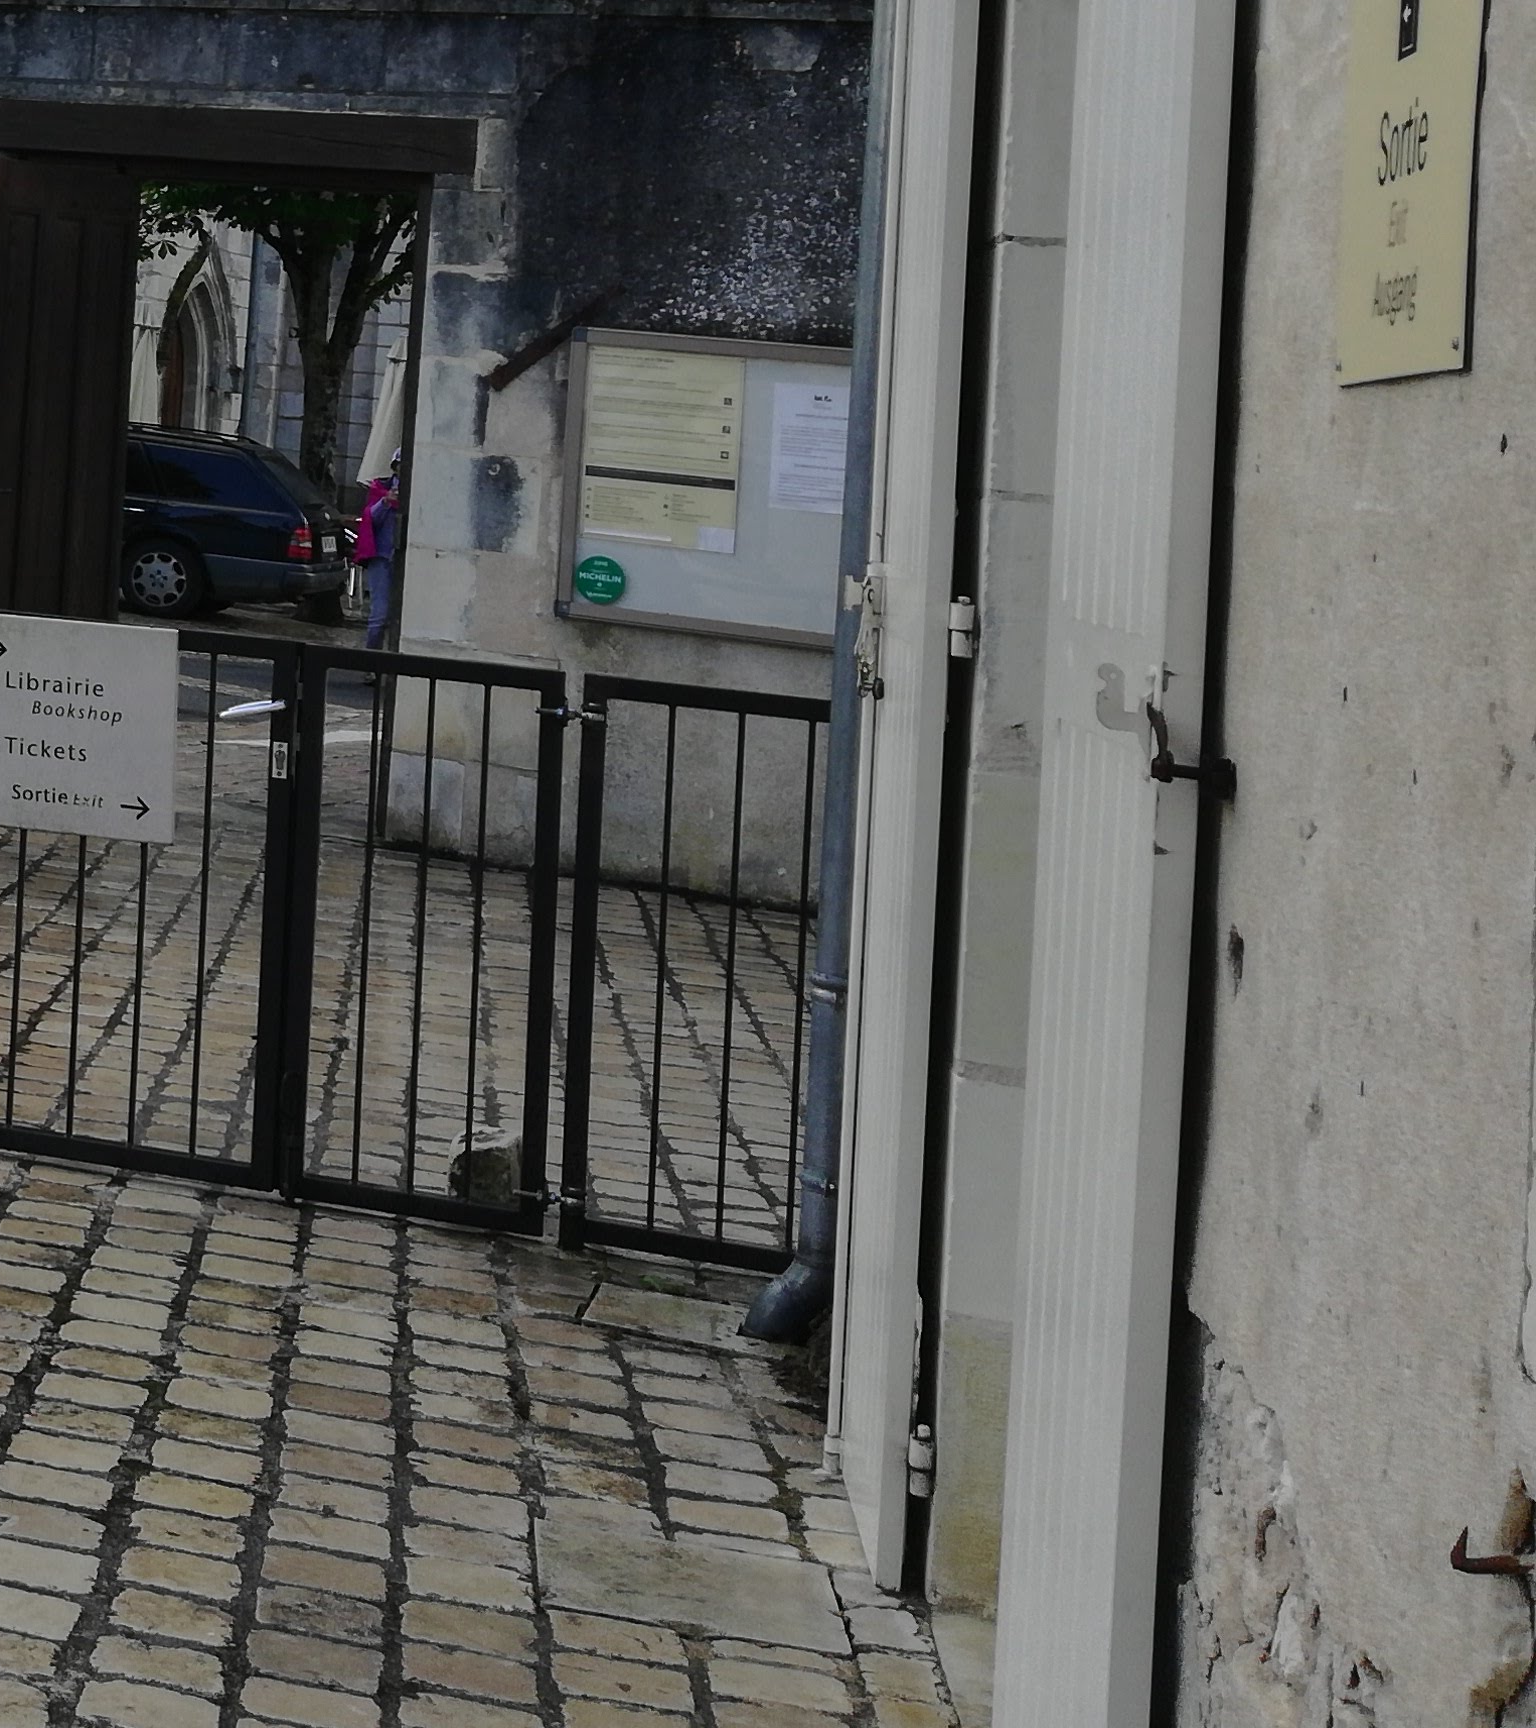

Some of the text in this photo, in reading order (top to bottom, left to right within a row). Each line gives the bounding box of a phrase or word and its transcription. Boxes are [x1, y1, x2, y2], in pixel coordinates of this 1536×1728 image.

[1377, 96, 1429, 186] Sortie
[579, 571, 622, 583] MICHELIN
[5, 670, 104, 697] Librairie
[31, 700, 123, 726] Bookshop
[4, 736, 88, 762] Tickets
[11, 783, 104, 809] Sortie Exit
